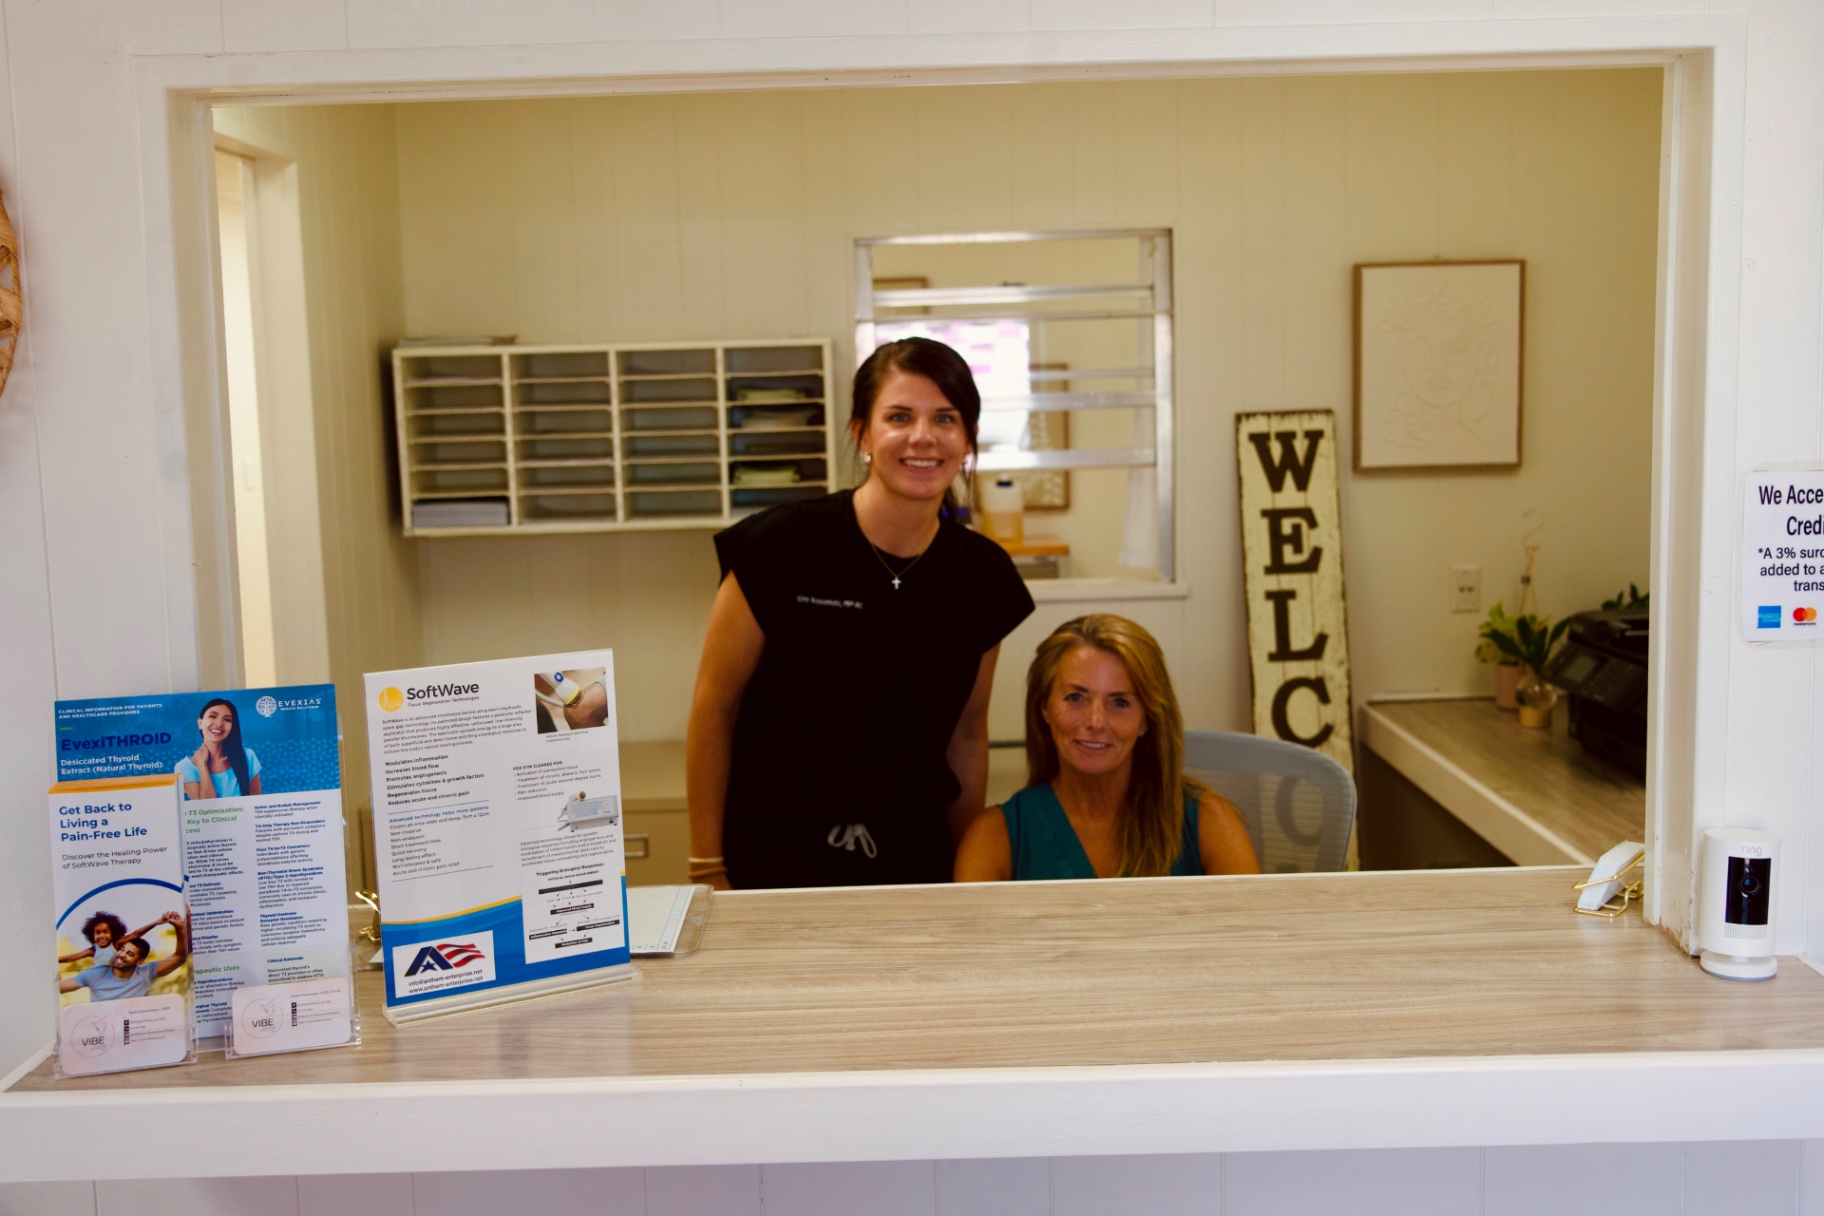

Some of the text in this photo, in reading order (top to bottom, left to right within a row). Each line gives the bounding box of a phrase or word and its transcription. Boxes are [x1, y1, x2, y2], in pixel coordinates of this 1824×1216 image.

[1758, 485, 1824, 505] We Acce
[1776, 547, 1797, 559] 3%
[1760, 563, 1799, 576] added
[1803, 563, 1816, 575] to
[1793, 580, 1824, 592] trans
[406, 683, 480, 701] SoftWave
[278, 698, 321, 707] EVEXIAS
[61, 731, 172, 751] EvexiTHROID
[61, 754, 139, 766] Desiccated Thyroid
[414, 755, 449, 763] inflammation
[61, 761, 163, 775] Extract (Natural Thyroid)
[447, 775, 466, 783] growth
[387, 790, 421, 798] Regenerates
[59, 803, 132, 815] Get Back to
[60, 818, 97, 829] Living
[61, 826, 148, 842] Pain-Free Life
[62, 853, 95, 861] Discover
[112, 848, 141, 857] Healing
[143, 846, 168, 854] Power
[1741, 844, 1762, 856] ring
[72, 861, 109, 869] SoftWave
[110, 858, 141, 866] Therapy
[194, 966, 222, 974] apeutic
[408, 969, 483, 987] info@anthem-enterprise.net
[409, 976, 484, 993] www.anthem-enterprise.net
[252, 1018, 274, 1028] VIBE
[81, 1036, 105, 1047] VIBE
